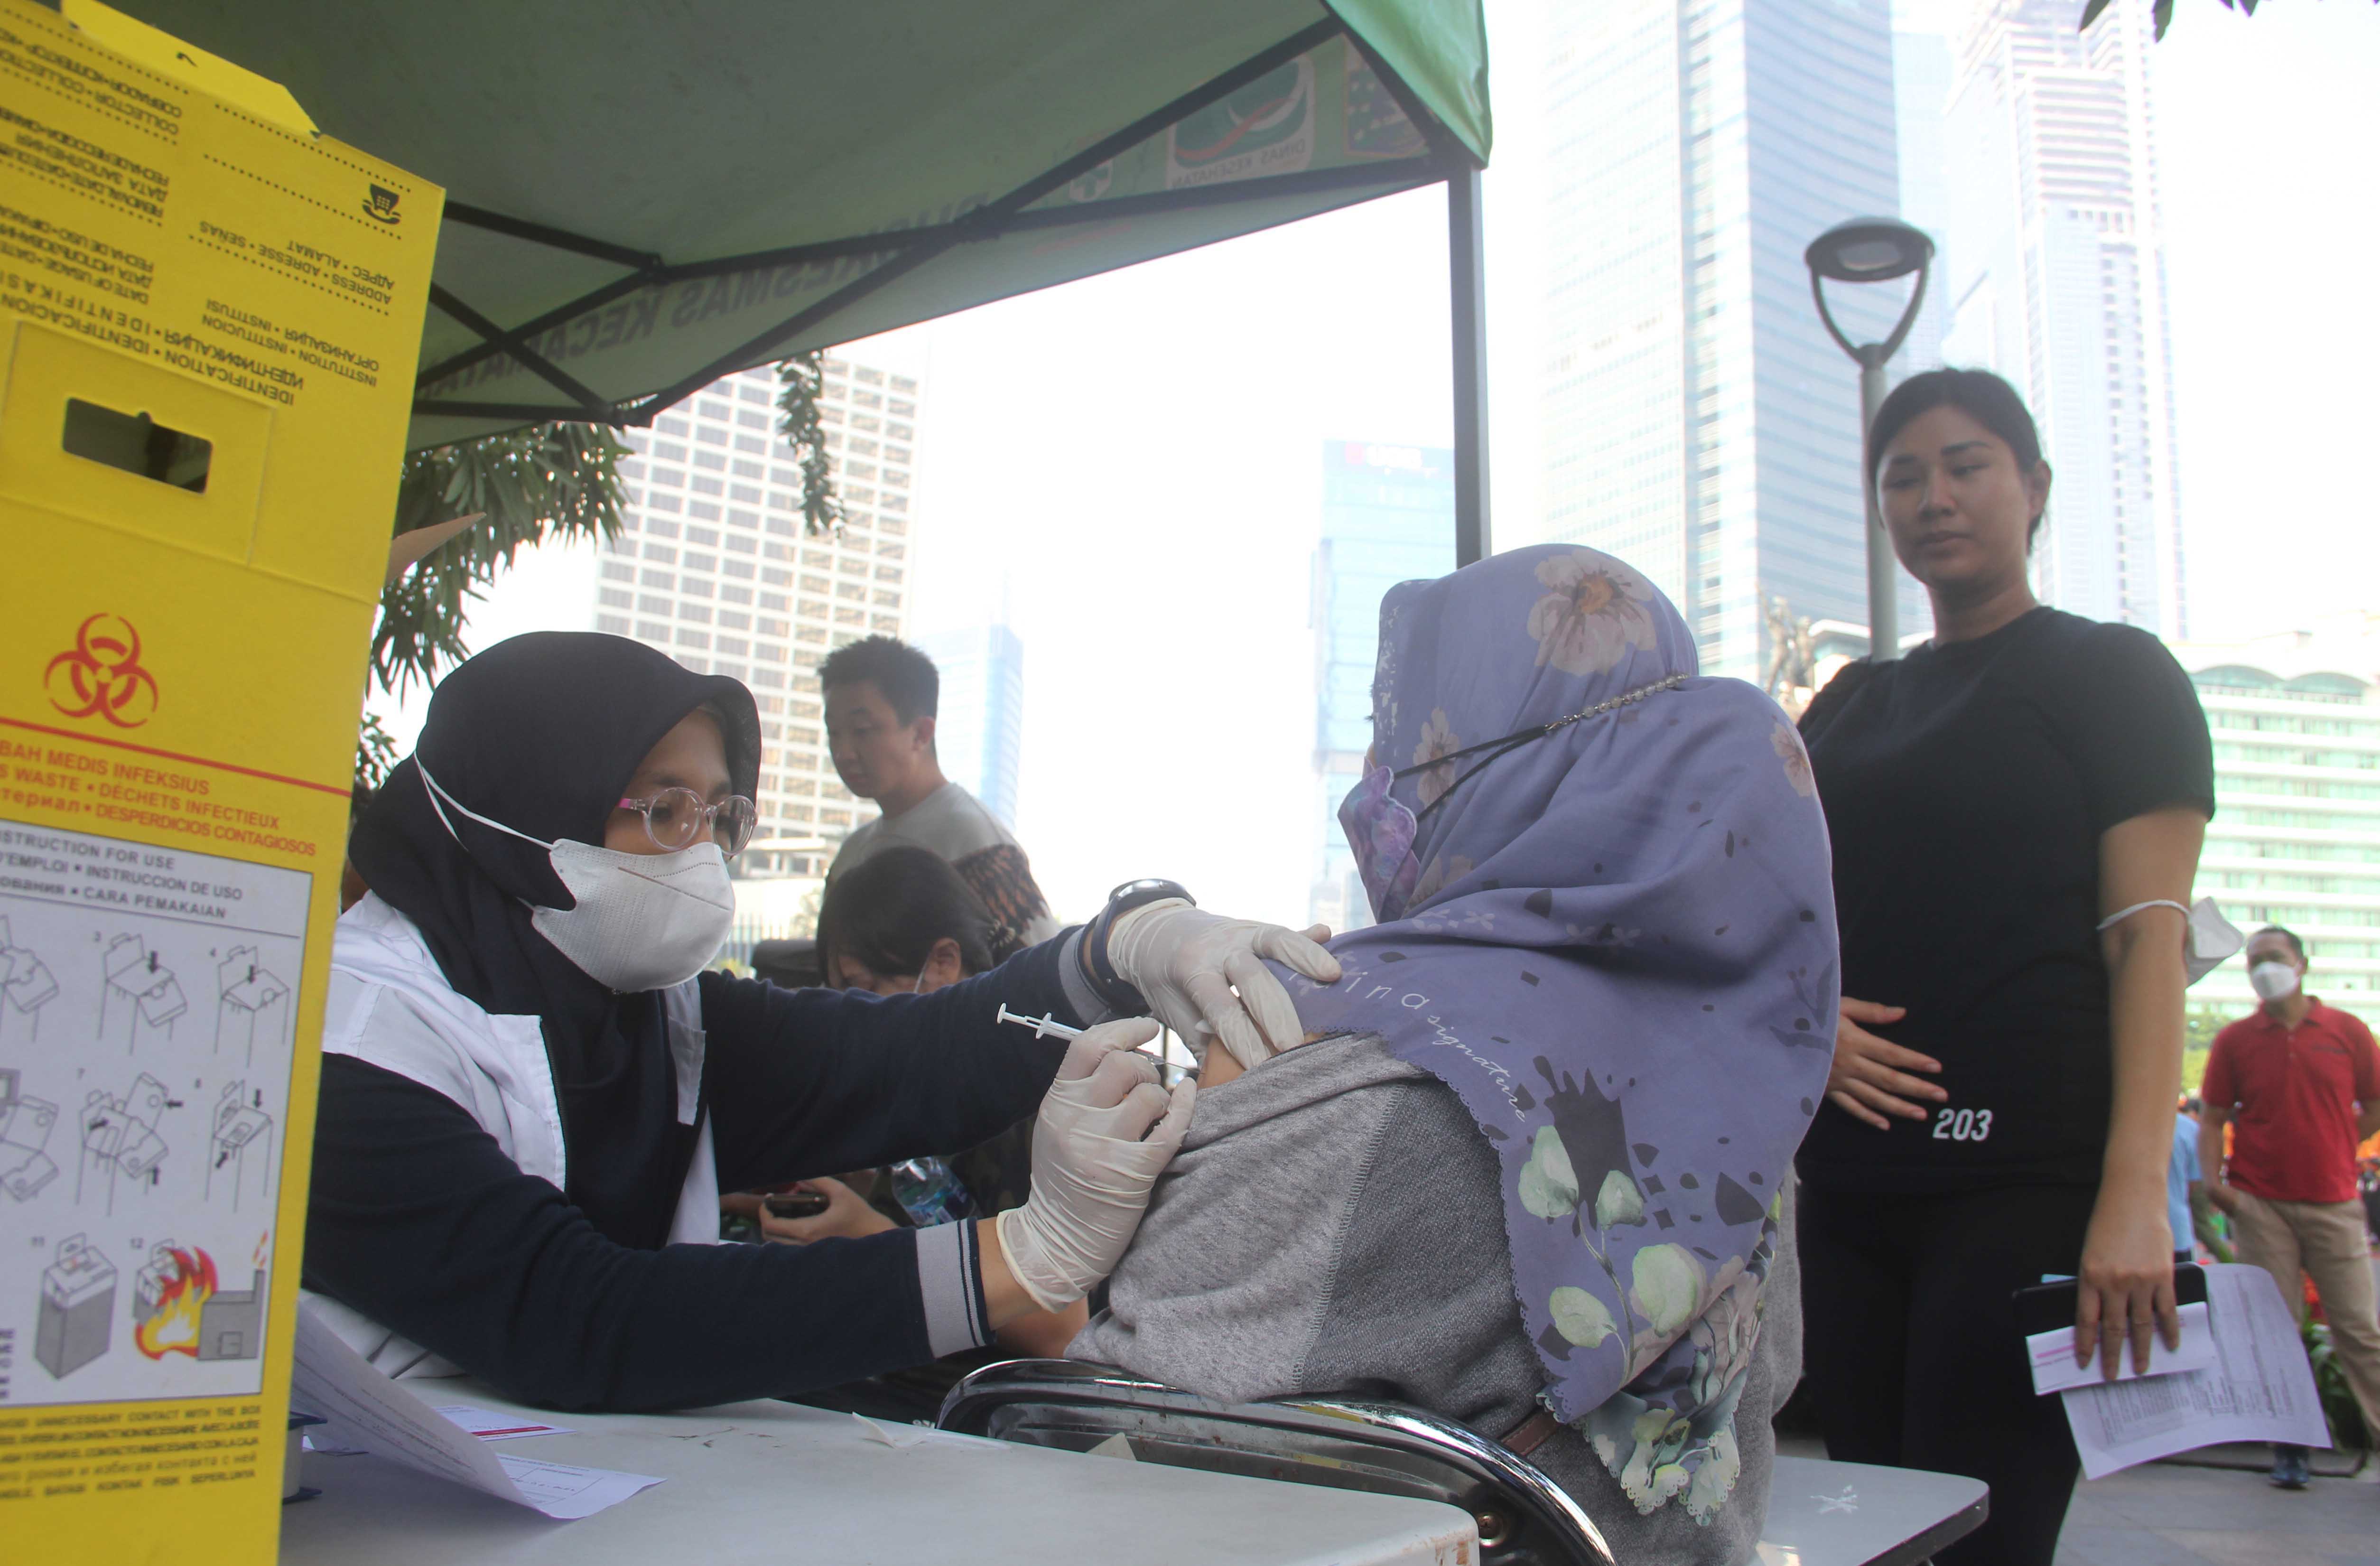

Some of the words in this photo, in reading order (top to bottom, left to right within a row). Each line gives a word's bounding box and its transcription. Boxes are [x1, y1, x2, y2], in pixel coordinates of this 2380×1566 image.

[93, 91, 179, 136] COLLECTOR
[256, 243, 321, 277] ADRESSE
[286, 239, 341, 269] ALAMAT
[329, 272, 391, 305] ADDRESS
[350, 264, 395, 290] АДРЕС
[0, 291, 151, 355] IDENTIFICACION
[205, 298, 272, 332] INSTITUSI
[200, 313, 288, 355] INSTITUCION
[163, 349, 295, 405] IDENTIFICATION
[297, 349, 377, 388] INSTITUTION
[47, 750, 109, 776] MEDIS
[114, 762, 210, 795] INFEKSIUS
[15, 767, 80, 792] WASTE
[186, 799, 279, 830] INFECTIEUX
[96, 803, 211, 839] DESPERDICIOS
[214, 824, 316, 857] CONTAGIOSOS
[105, 847, 139, 864] FOR
[144, 854, 175, 870] USE
[86, 865, 186, 891] INSTRUCCION
[191, 881, 209, 895] DE
[213, 885, 242, 901] USO
[84, 886, 129, 904] CARA
[136, 893, 226, 919] PEMAKAIAN
[1427, 1015, 1526, 1123] signature
[1932, 1108, 1993, 1141] 203
